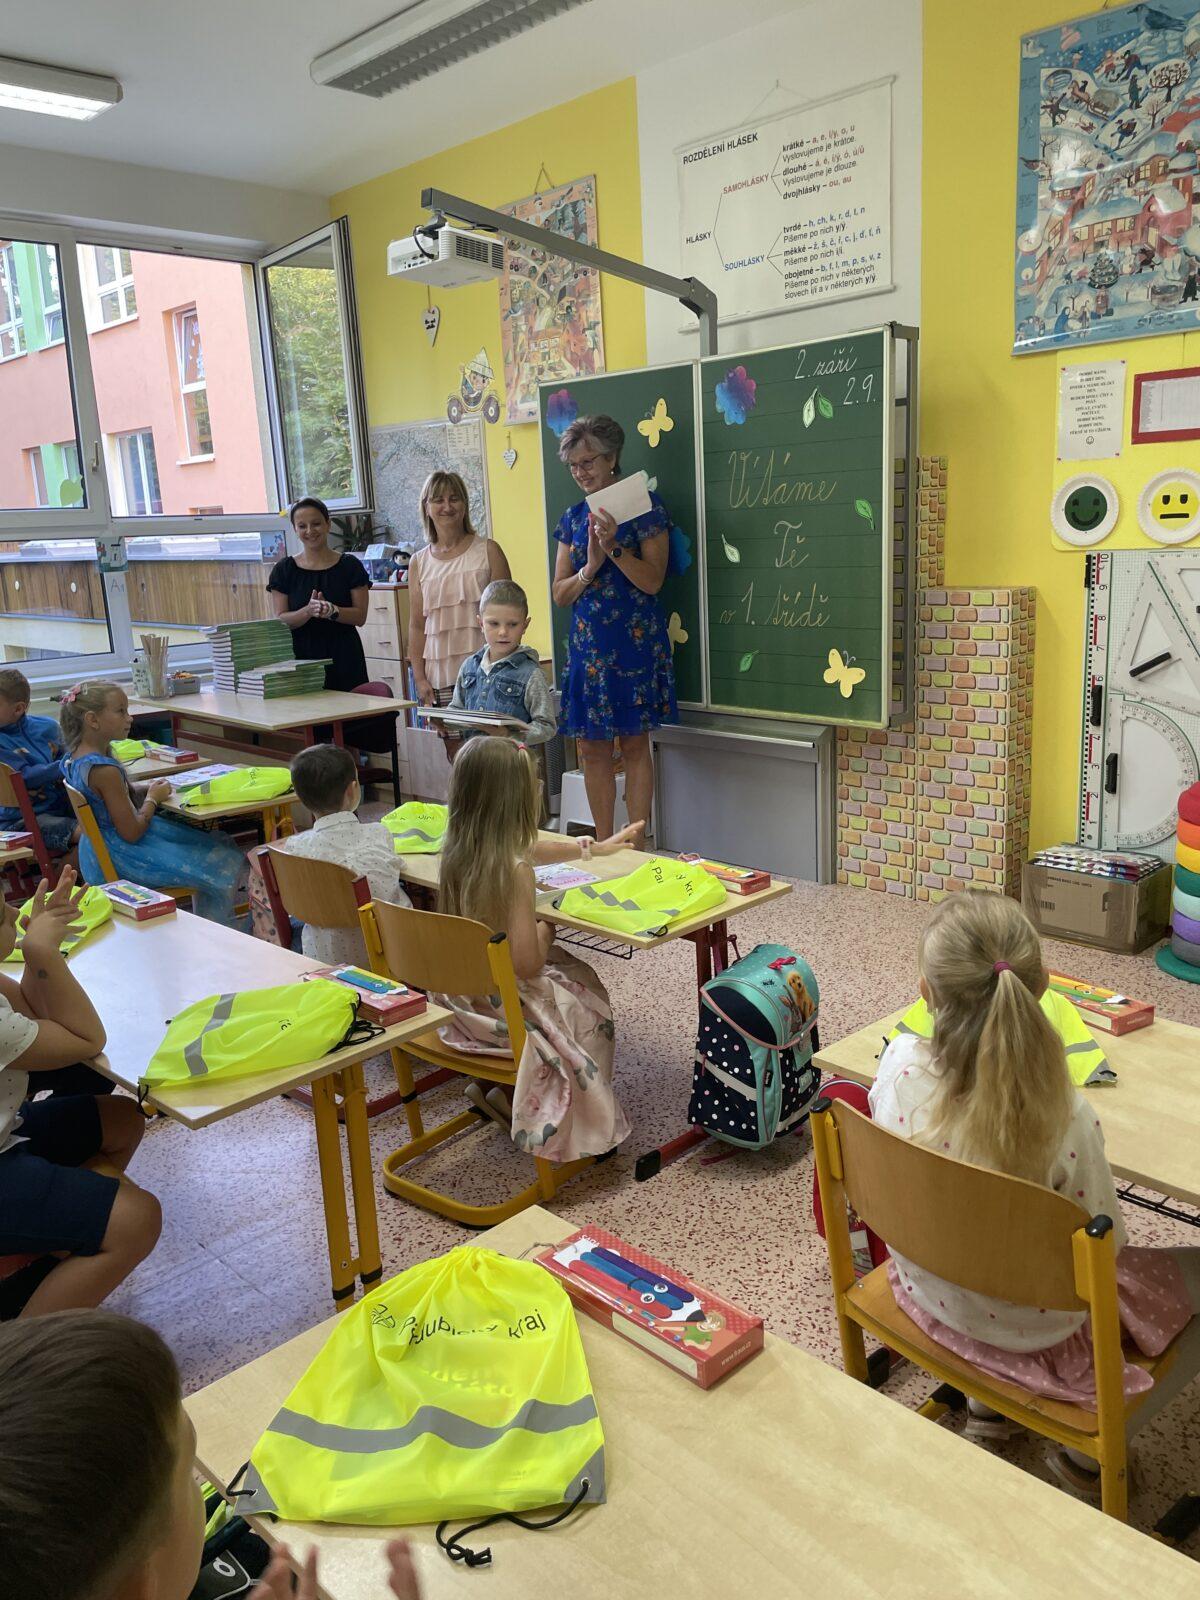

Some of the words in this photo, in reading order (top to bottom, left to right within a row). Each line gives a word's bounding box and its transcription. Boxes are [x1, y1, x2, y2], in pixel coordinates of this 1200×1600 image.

[683, 140, 724, 164] ROZDĚLENÍ
[727, 132, 758, 150] HLÁSEK
[782, 146, 824, 163] Vyslovujeme
[826, 143, 832, 152] je
[723, 173, 769, 194] SAMOHLÁSKY
[782, 170, 824, 187] Vyslovujeme
[826, 167, 832, 176] je
[782, 184, 820, 200] dvojhlásky
[686, 231, 712, 244] HLÁSKY
[810, 230, 818, 238] po
[820, 226, 834, 234] nich
[724, 254, 764, 272] SOUHLÁSKY
[810, 254, 818, 262] po
[820, 250, 834, 258] nich
[784, 266, 814, 280] obojetné
[810, 276, 818, 286] po
[820, 273, 834, 282] nich
[842, 264, 874, 278] některých
[784, 287, 808, 300] slovech
[830, 276, 864, 290] některých
[812, 346, 858, 376] září
[728, 450, 837, 508] Vítáme
[774, 520, 810, 568] Tě
[1100, 553, 1110, 562] 10
[741, 581, 756, 626] 1.
[765, 582, 830, 627] třídě
